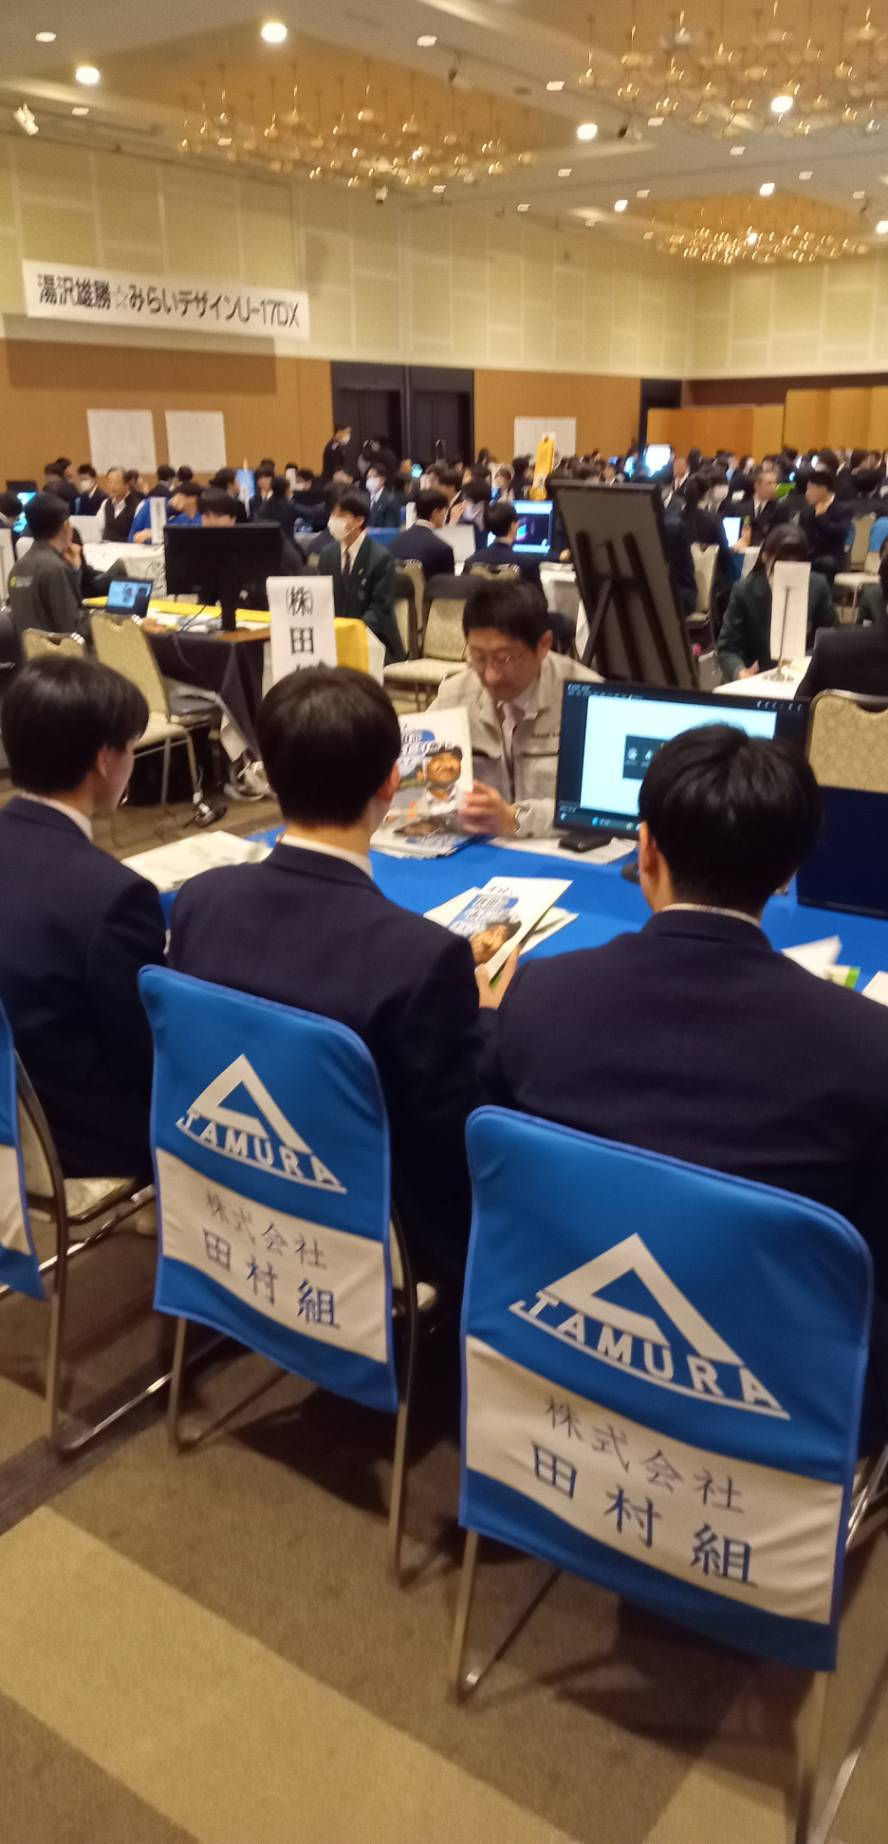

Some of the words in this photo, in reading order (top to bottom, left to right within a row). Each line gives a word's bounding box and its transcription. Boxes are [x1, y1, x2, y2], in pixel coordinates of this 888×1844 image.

[184, 1108, 343, 1187] TAMURA
[202, 1227, 341, 1330] 田村組
[206, 1187, 327, 1270] 株式会社
[530, 1290, 784, 1411] TAMURA
[545, 1395, 745, 1514] 株式会社
[531, 1440, 759, 1588] 田村組
